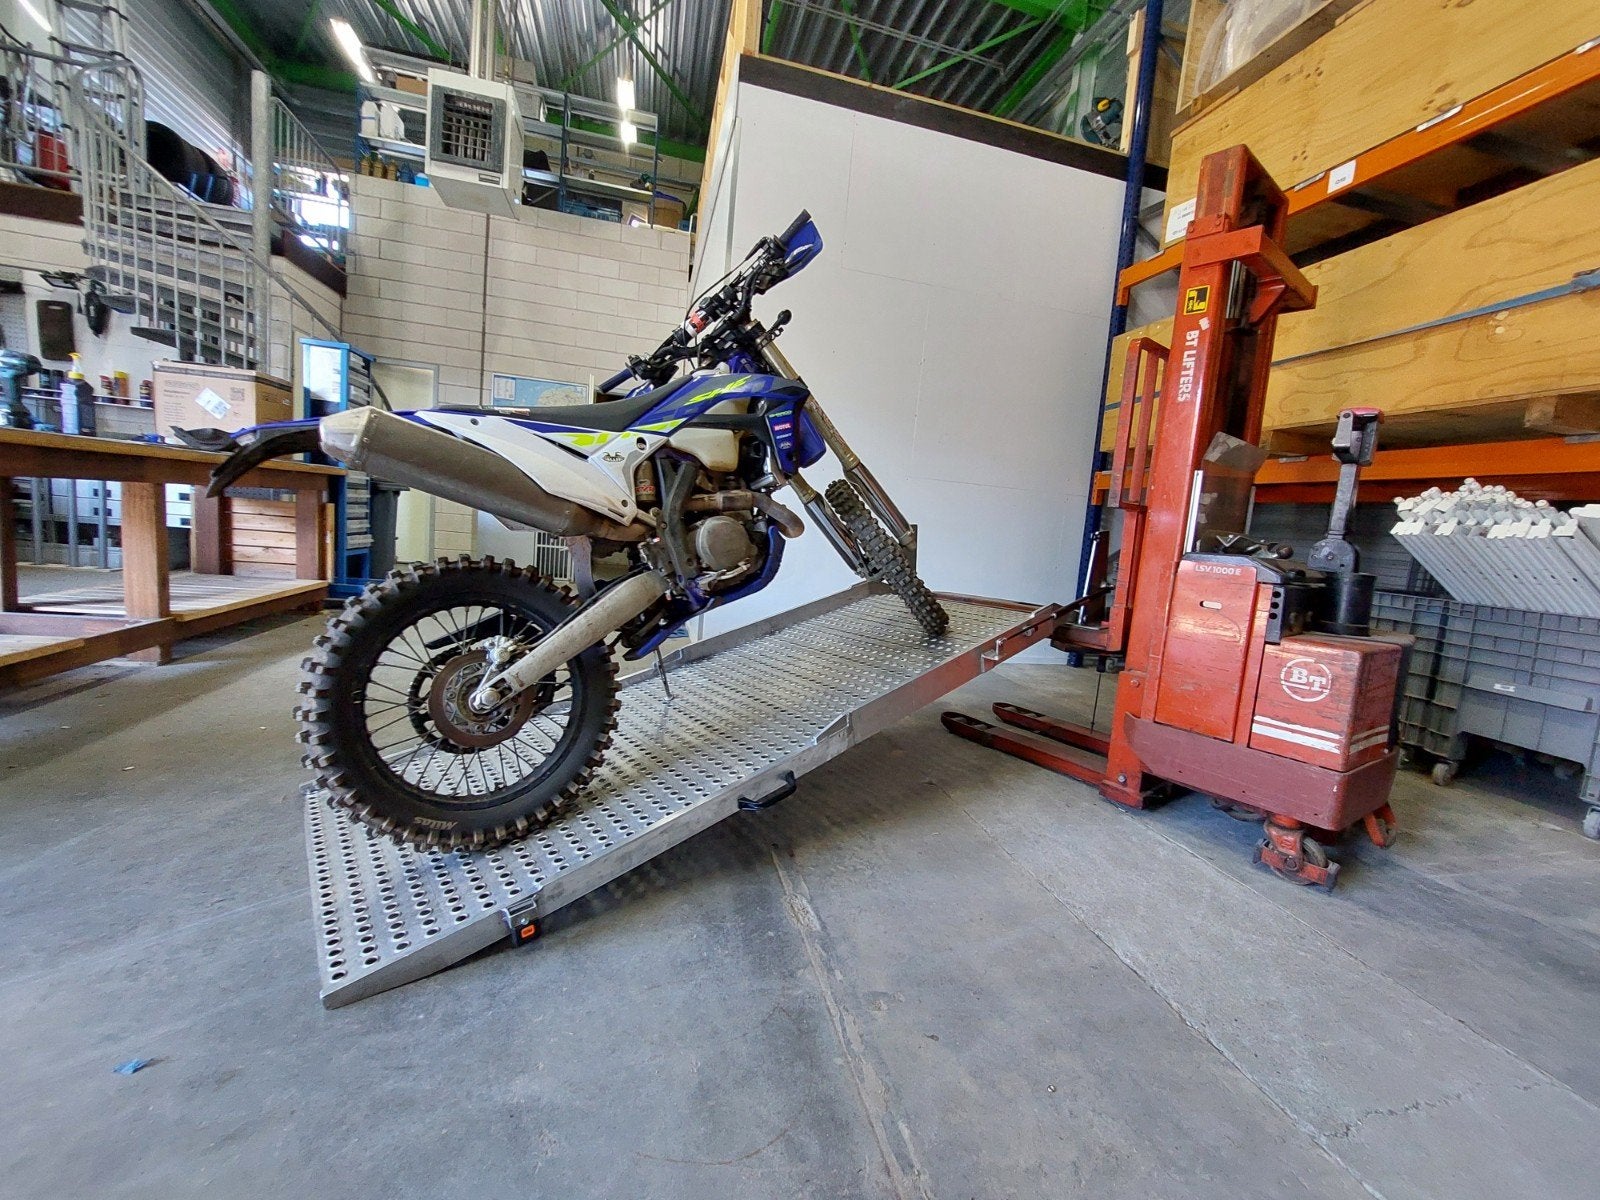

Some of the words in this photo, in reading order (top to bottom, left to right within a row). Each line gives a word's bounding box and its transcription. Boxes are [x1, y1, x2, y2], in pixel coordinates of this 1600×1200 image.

[1184, 329, 1200, 347] BT
[1177, 350, 1197, 402] LIFTERS
[1212, 565, 1235, 575] 1000
[1289, 666, 1327, 691] BT
